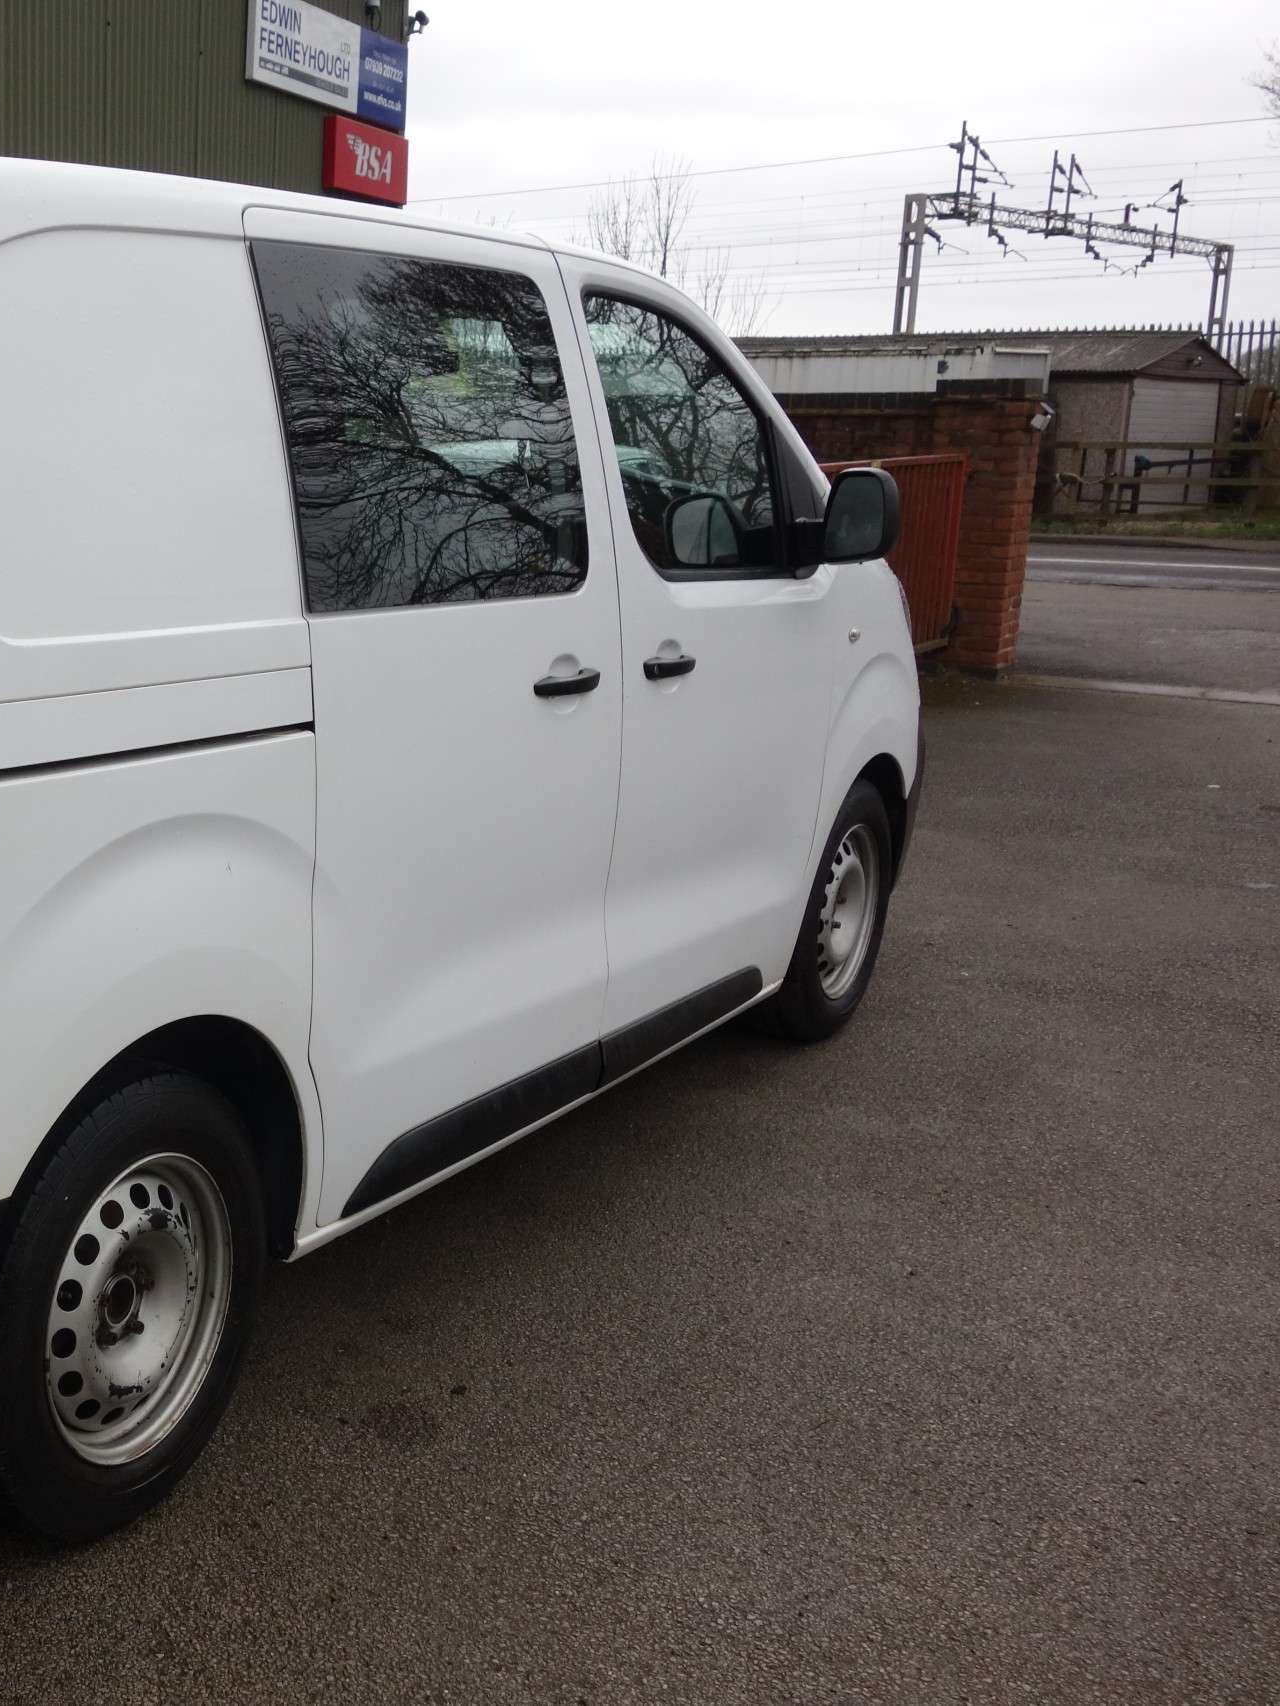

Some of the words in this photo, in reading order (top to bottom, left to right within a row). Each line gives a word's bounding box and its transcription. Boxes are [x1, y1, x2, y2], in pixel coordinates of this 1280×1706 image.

[261, 0, 302, 35] EDWIN
[259, 27, 351, 82] FERNEYHOUGH
[355, 141, 393, 185] BSA
